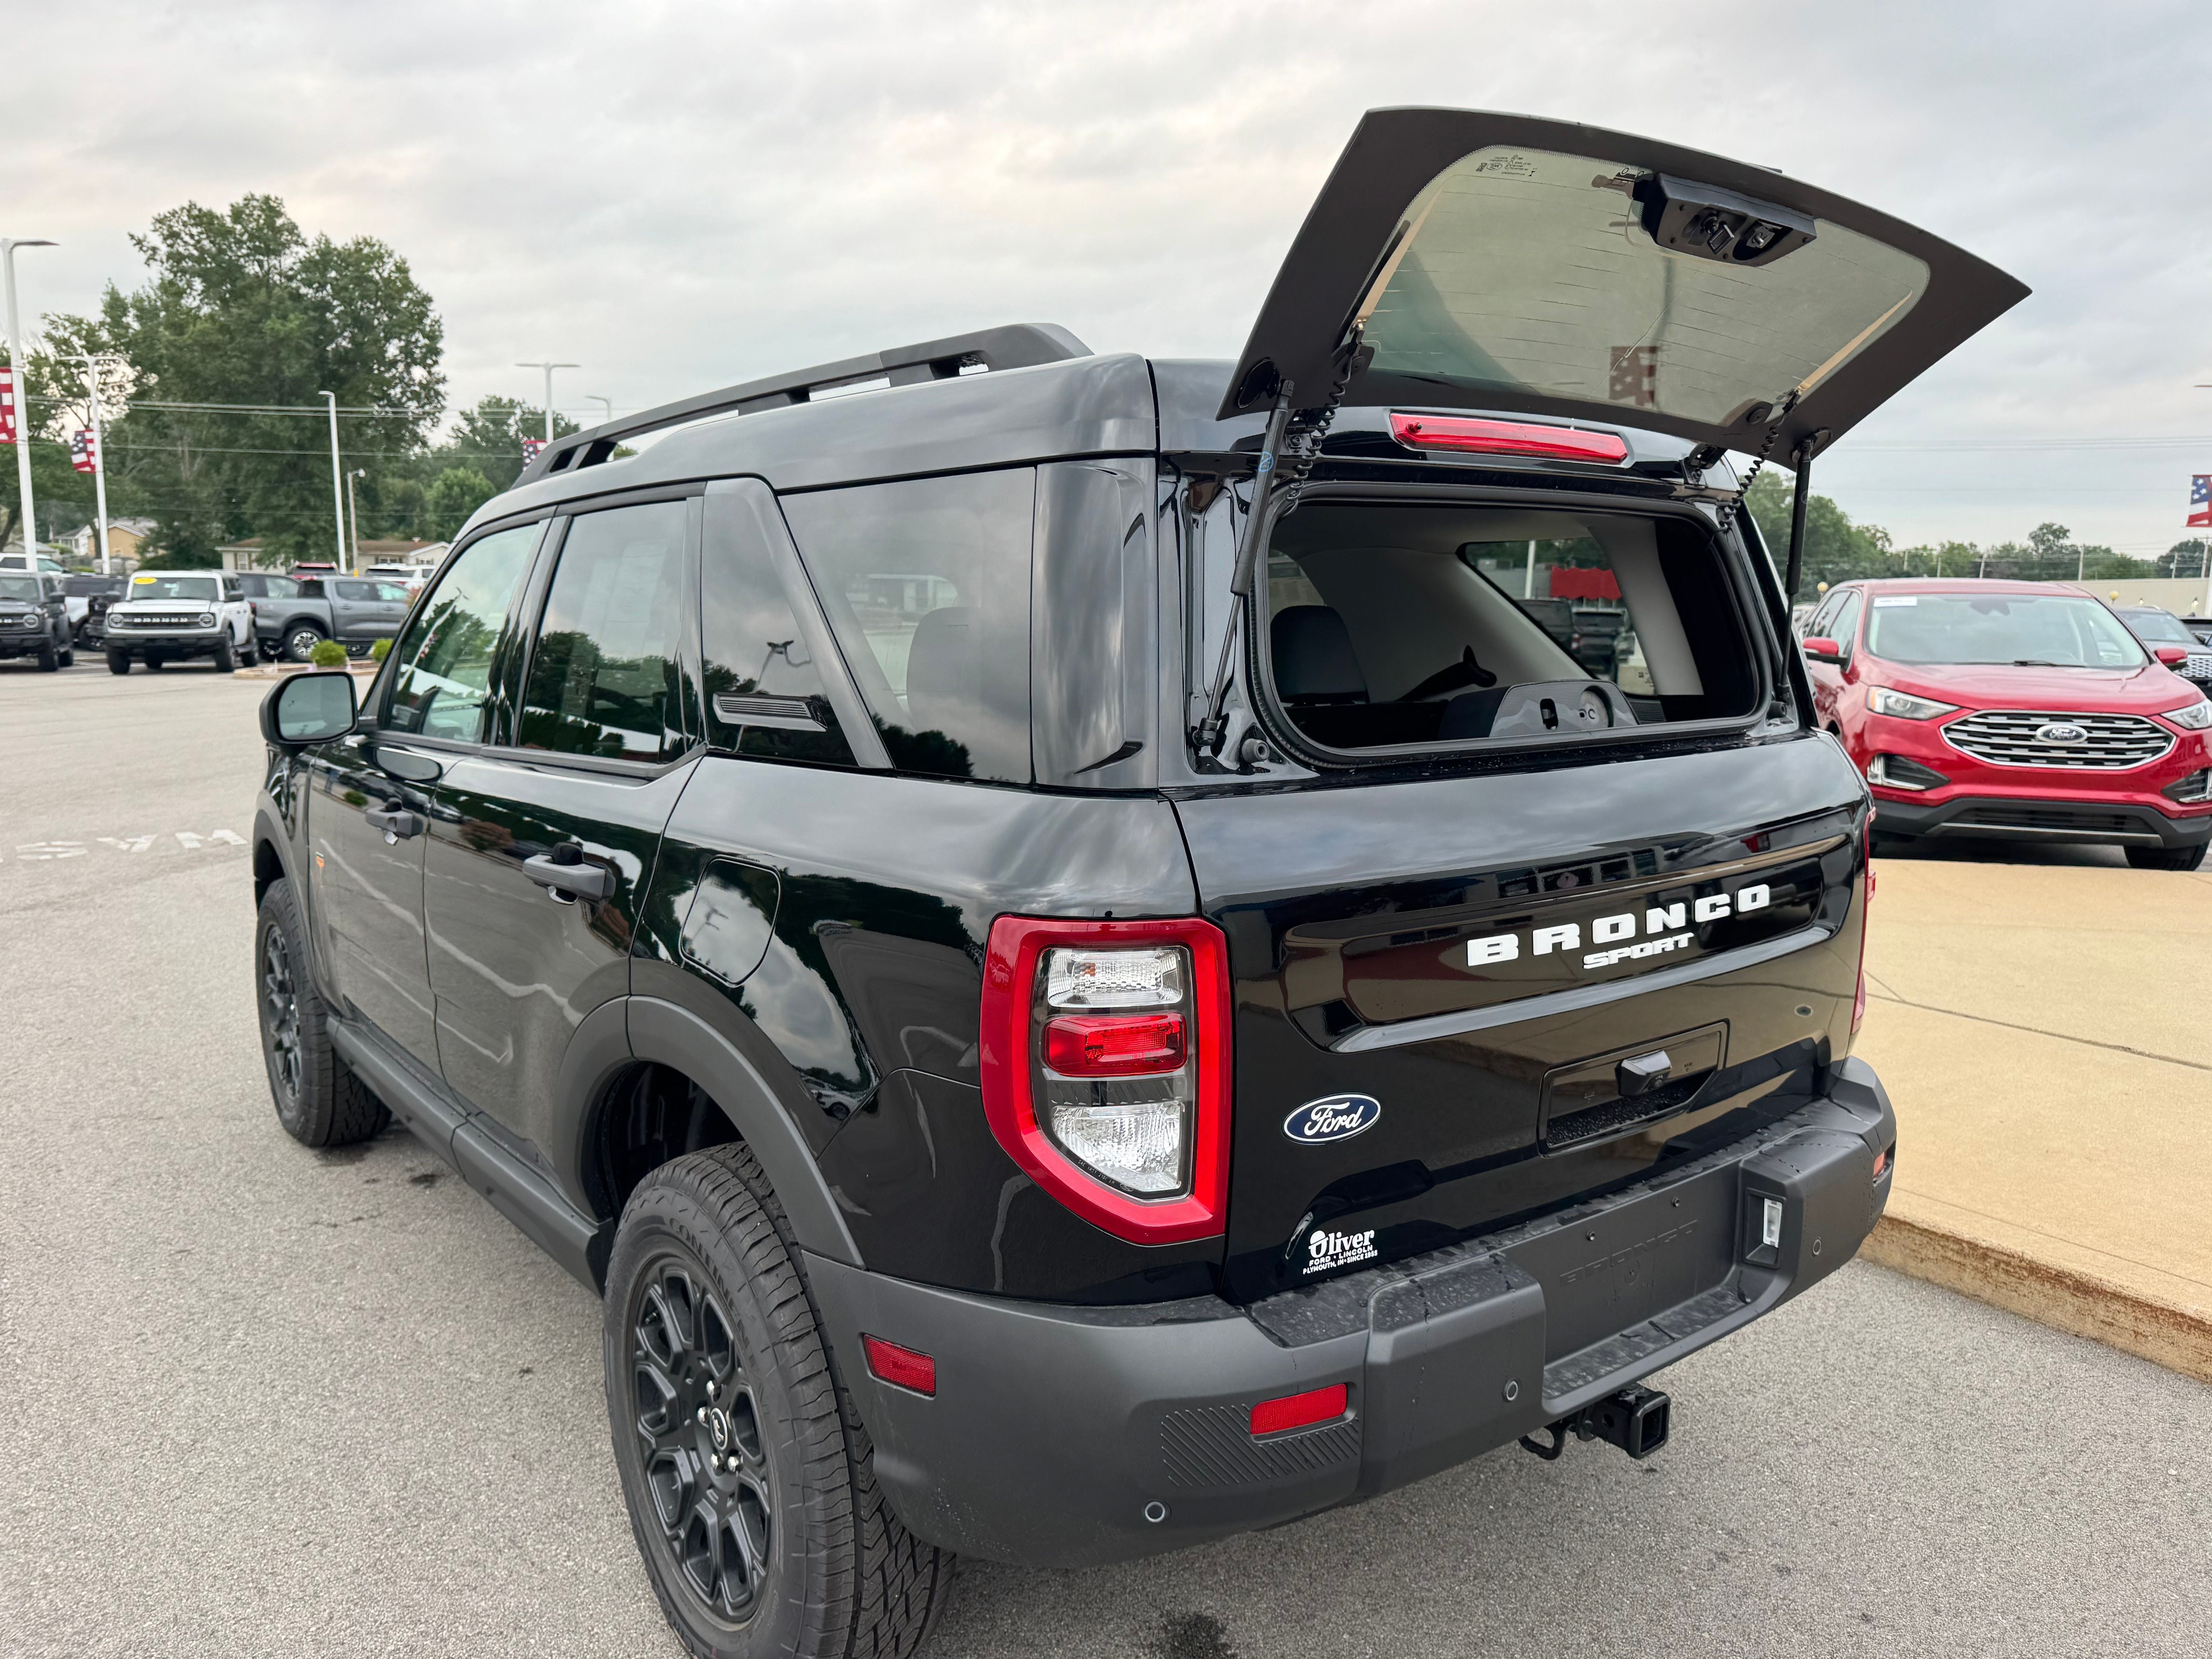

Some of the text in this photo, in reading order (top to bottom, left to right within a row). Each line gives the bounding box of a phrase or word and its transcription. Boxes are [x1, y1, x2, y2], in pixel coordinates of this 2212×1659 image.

[0, 829, 248, 863] WAS
[1467, 884, 1770, 967] BRONCO
[1583, 932, 1694, 970] SPORT
[1304, 1101, 1365, 1136] Ford
[1308, 1230, 1375, 1258] Oliver
[1309, 1244, 1373, 1267] FORD LINCOLN
[1559, 1219, 1698, 1287] BRONCO
